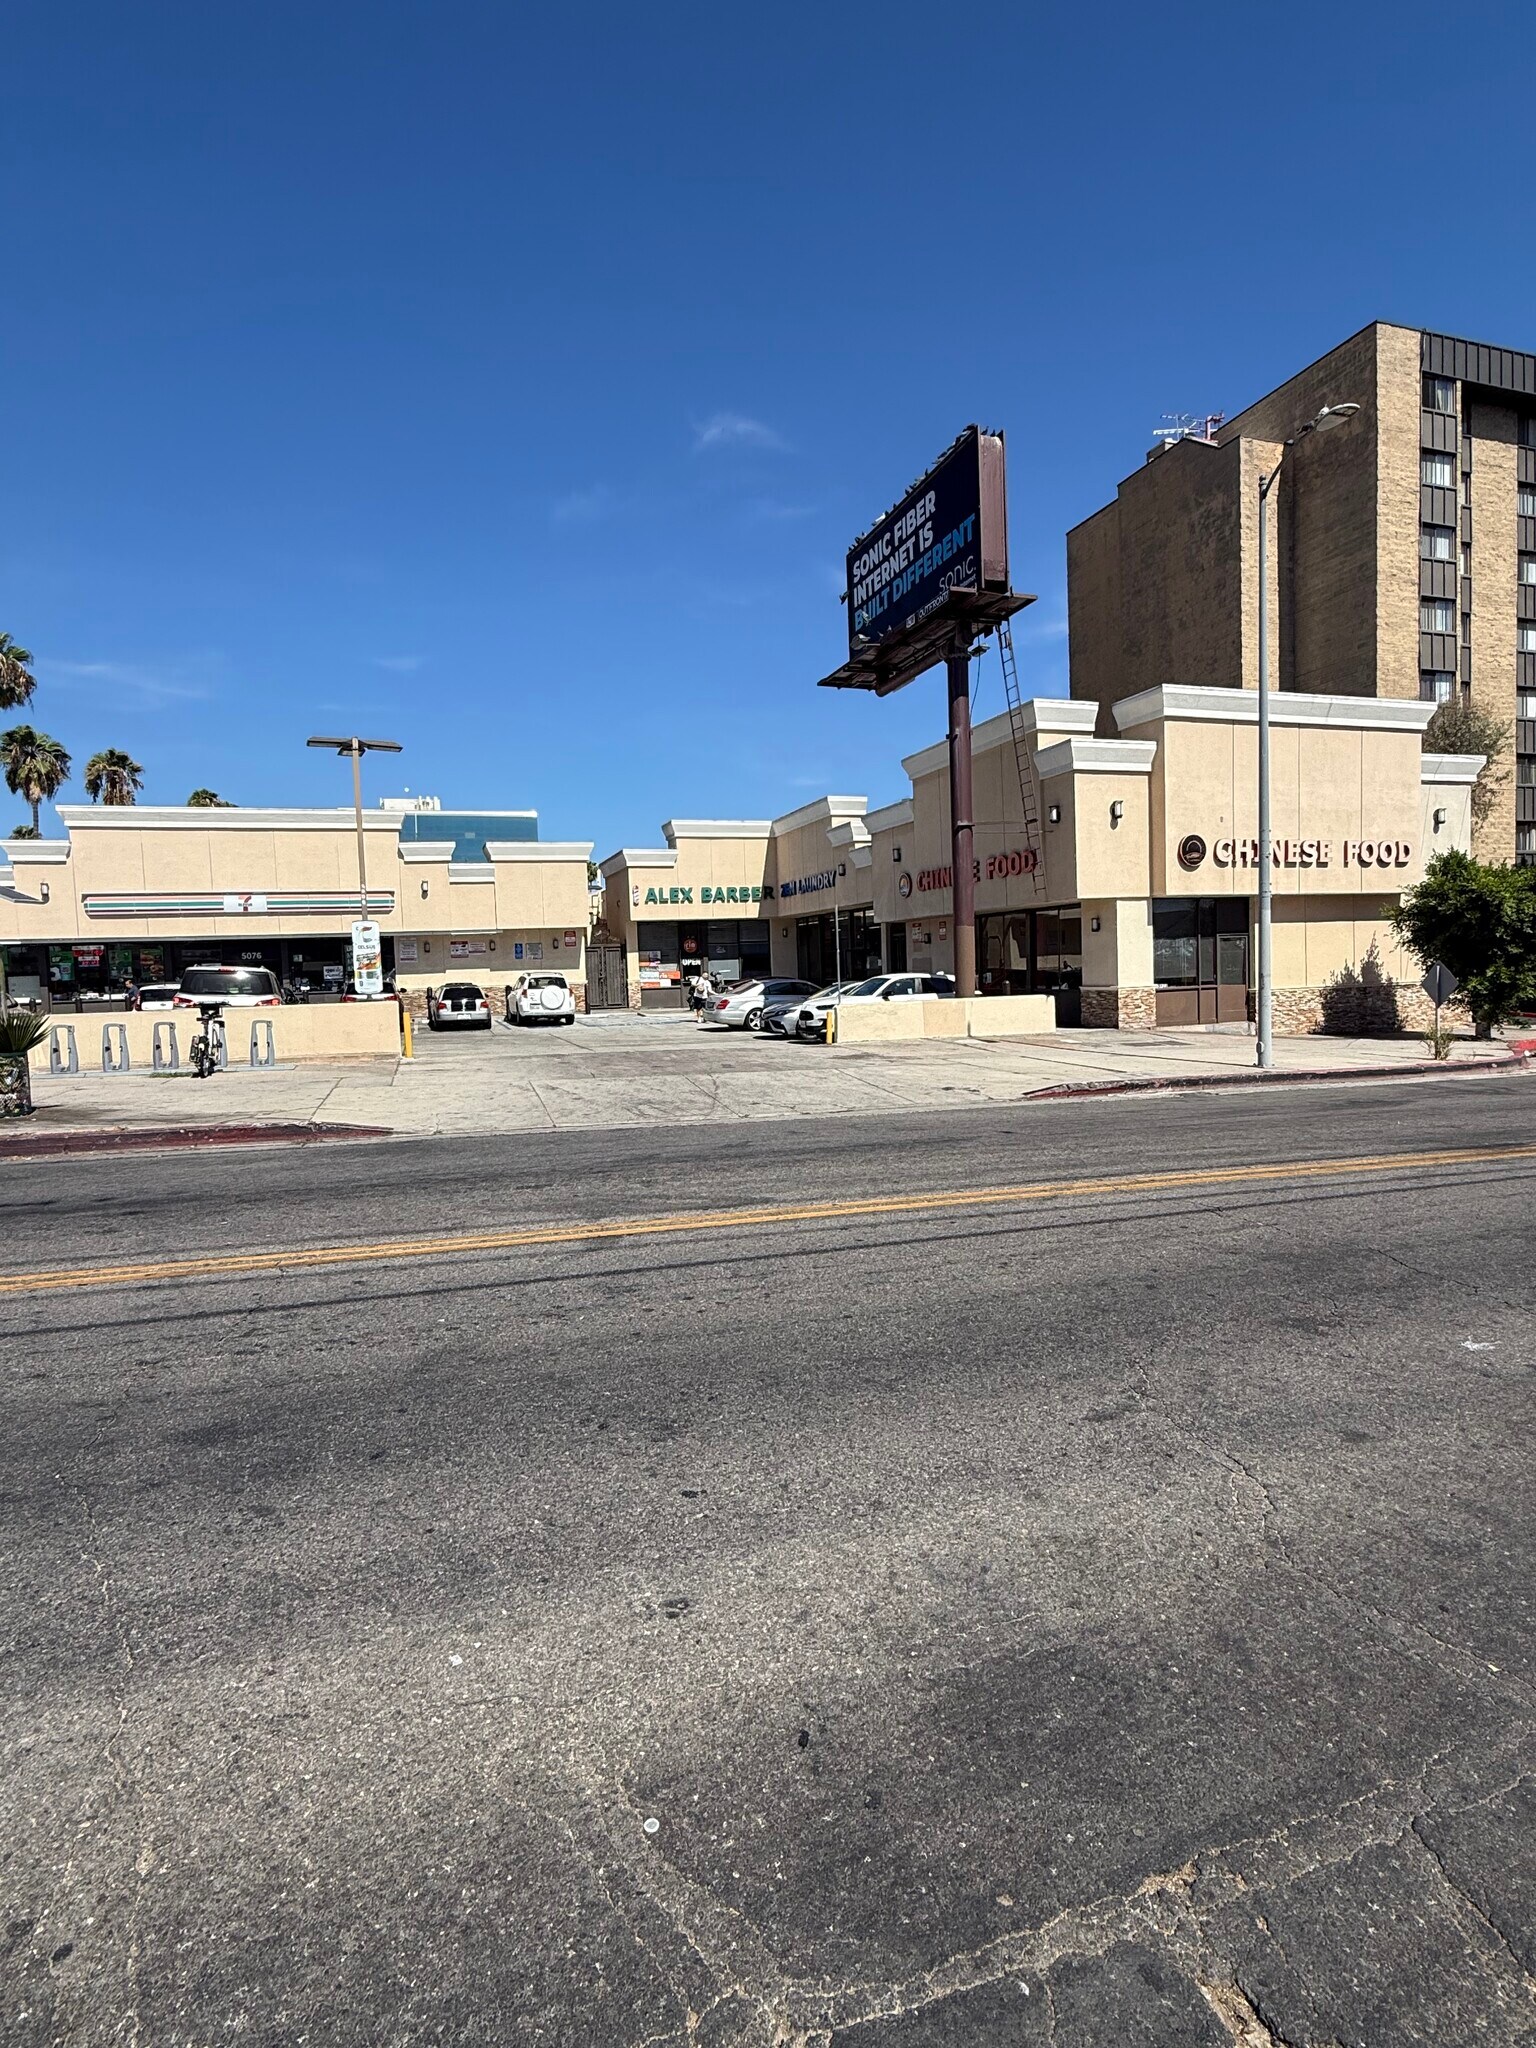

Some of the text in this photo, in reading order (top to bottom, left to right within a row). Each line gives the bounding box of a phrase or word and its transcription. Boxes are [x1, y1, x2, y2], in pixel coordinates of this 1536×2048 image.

[853, 490, 936, 583] SONIC FIBER
[853, 521, 934, 608] INTERNET IS
[854, 513, 976, 632] BUILT DIFFERENT
[1343, 839, 1414, 867] FOOD
[797, 869, 837, 895] LAUNDRY
[917, 849, 1037, 892] CHINE FOOD
[645, 885, 775, 905] ALEX BARBER
[241, 952, 262, 960] 5076
[682, 958, 701, 967] OPEN
